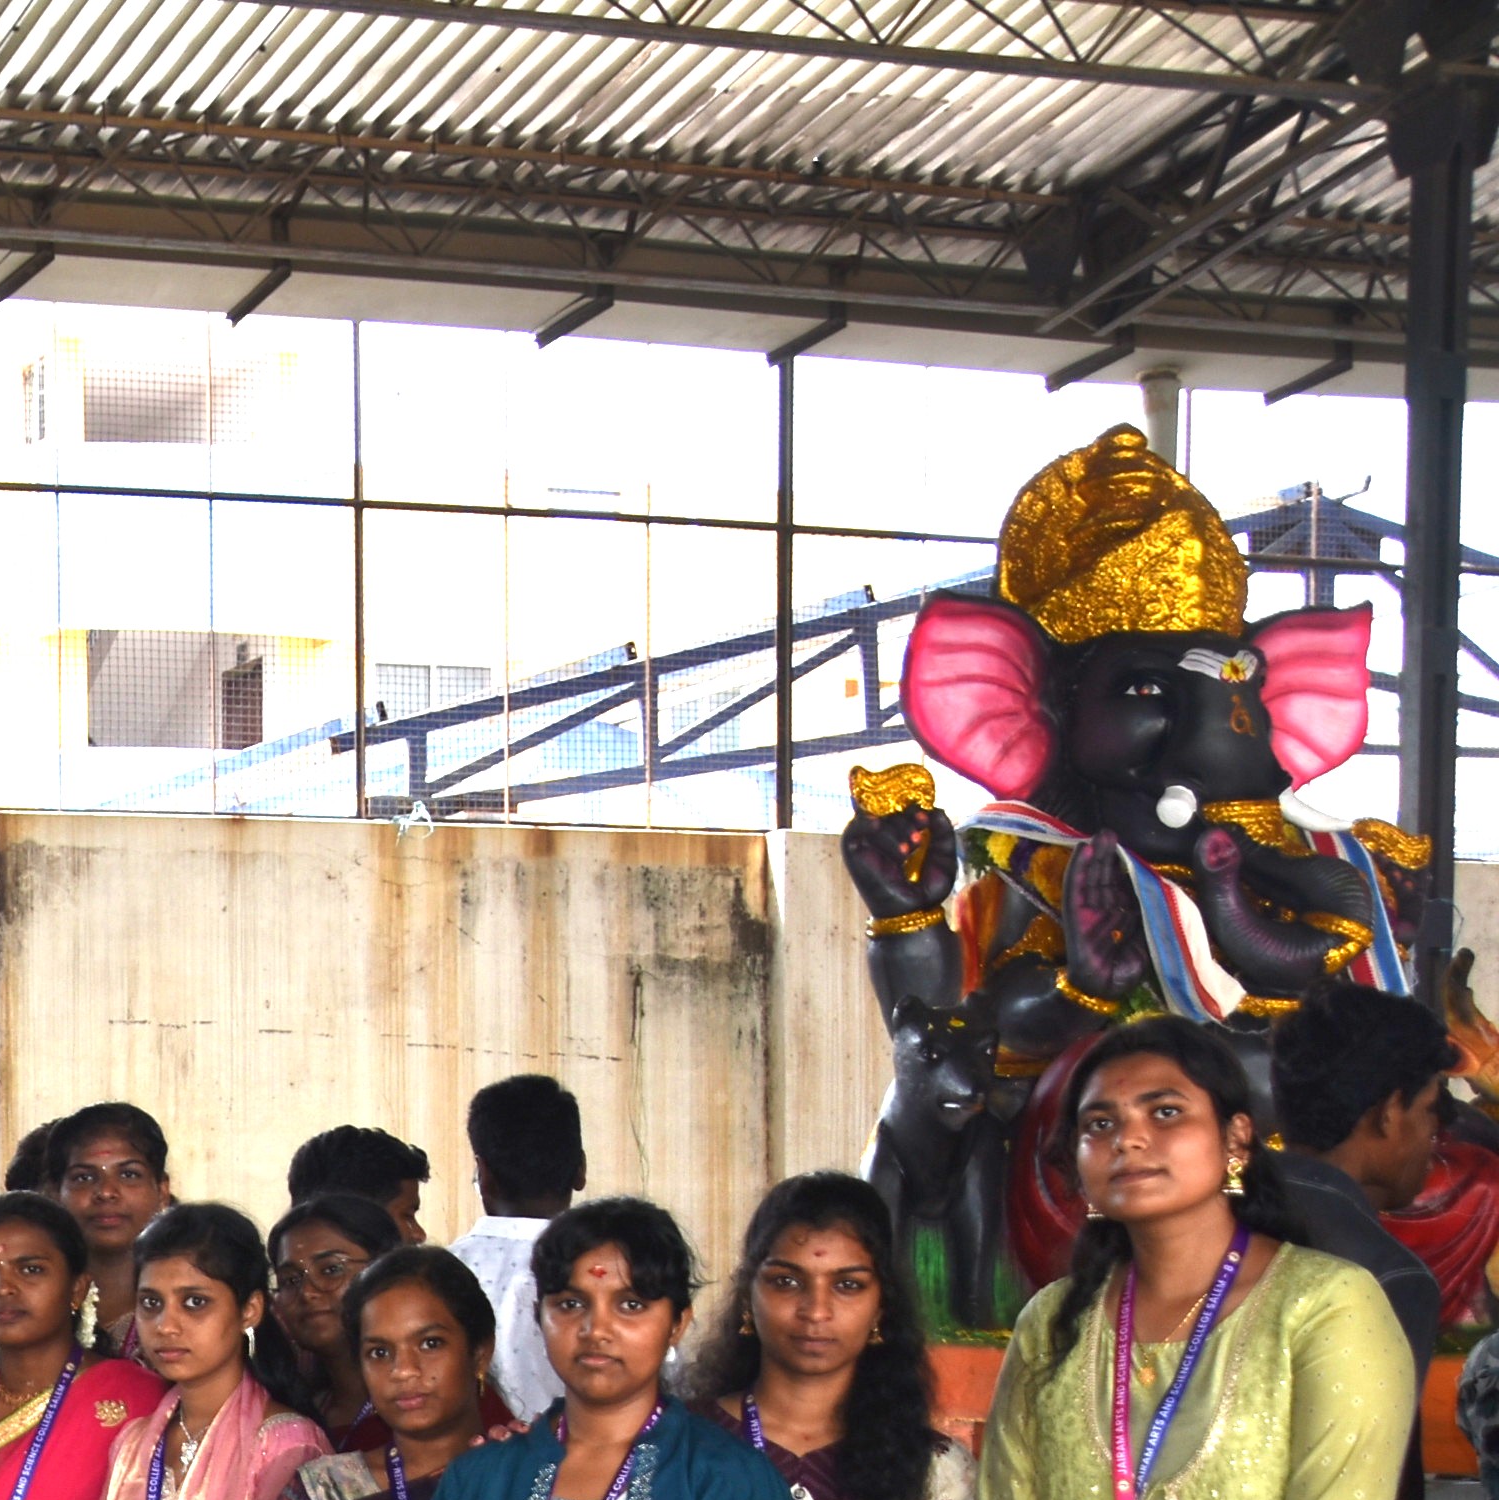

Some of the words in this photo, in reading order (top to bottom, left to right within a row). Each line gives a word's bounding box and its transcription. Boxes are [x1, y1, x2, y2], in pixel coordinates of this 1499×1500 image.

[1119, 1303, 1130, 1342] COLLEGE
[1117, 1344, 1127, 1383] SCIENCE
[1148, 1419, 1165, 1446] ARTS
[1160, 1397, 1174, 1418] AND
[1170, 1354, 1194, 1395] SCIENCE
[1188, 1311, 1212, 1352] COLLEGE
[1206, 1279, 1226, 1309] SALEM
[1116, 1385, 1125, 1405] AND
[751, 1419, 764, 1448] SALEM
[1116, 1407, 1124, 1432] ARTS
[16, 1476, 27, 1495] AND
[22, 1443, 40, 1476] SCIENCE
[36, 1410, 54, 1442] COLLEGE
[49, 1384, 65, 1409] SALEM
[1116, 1434, 1128, 1475] JAIRAM
[148, 1459, 160, 1492] COLLEGE
[394, 1467, 405, 1490] SALEM
